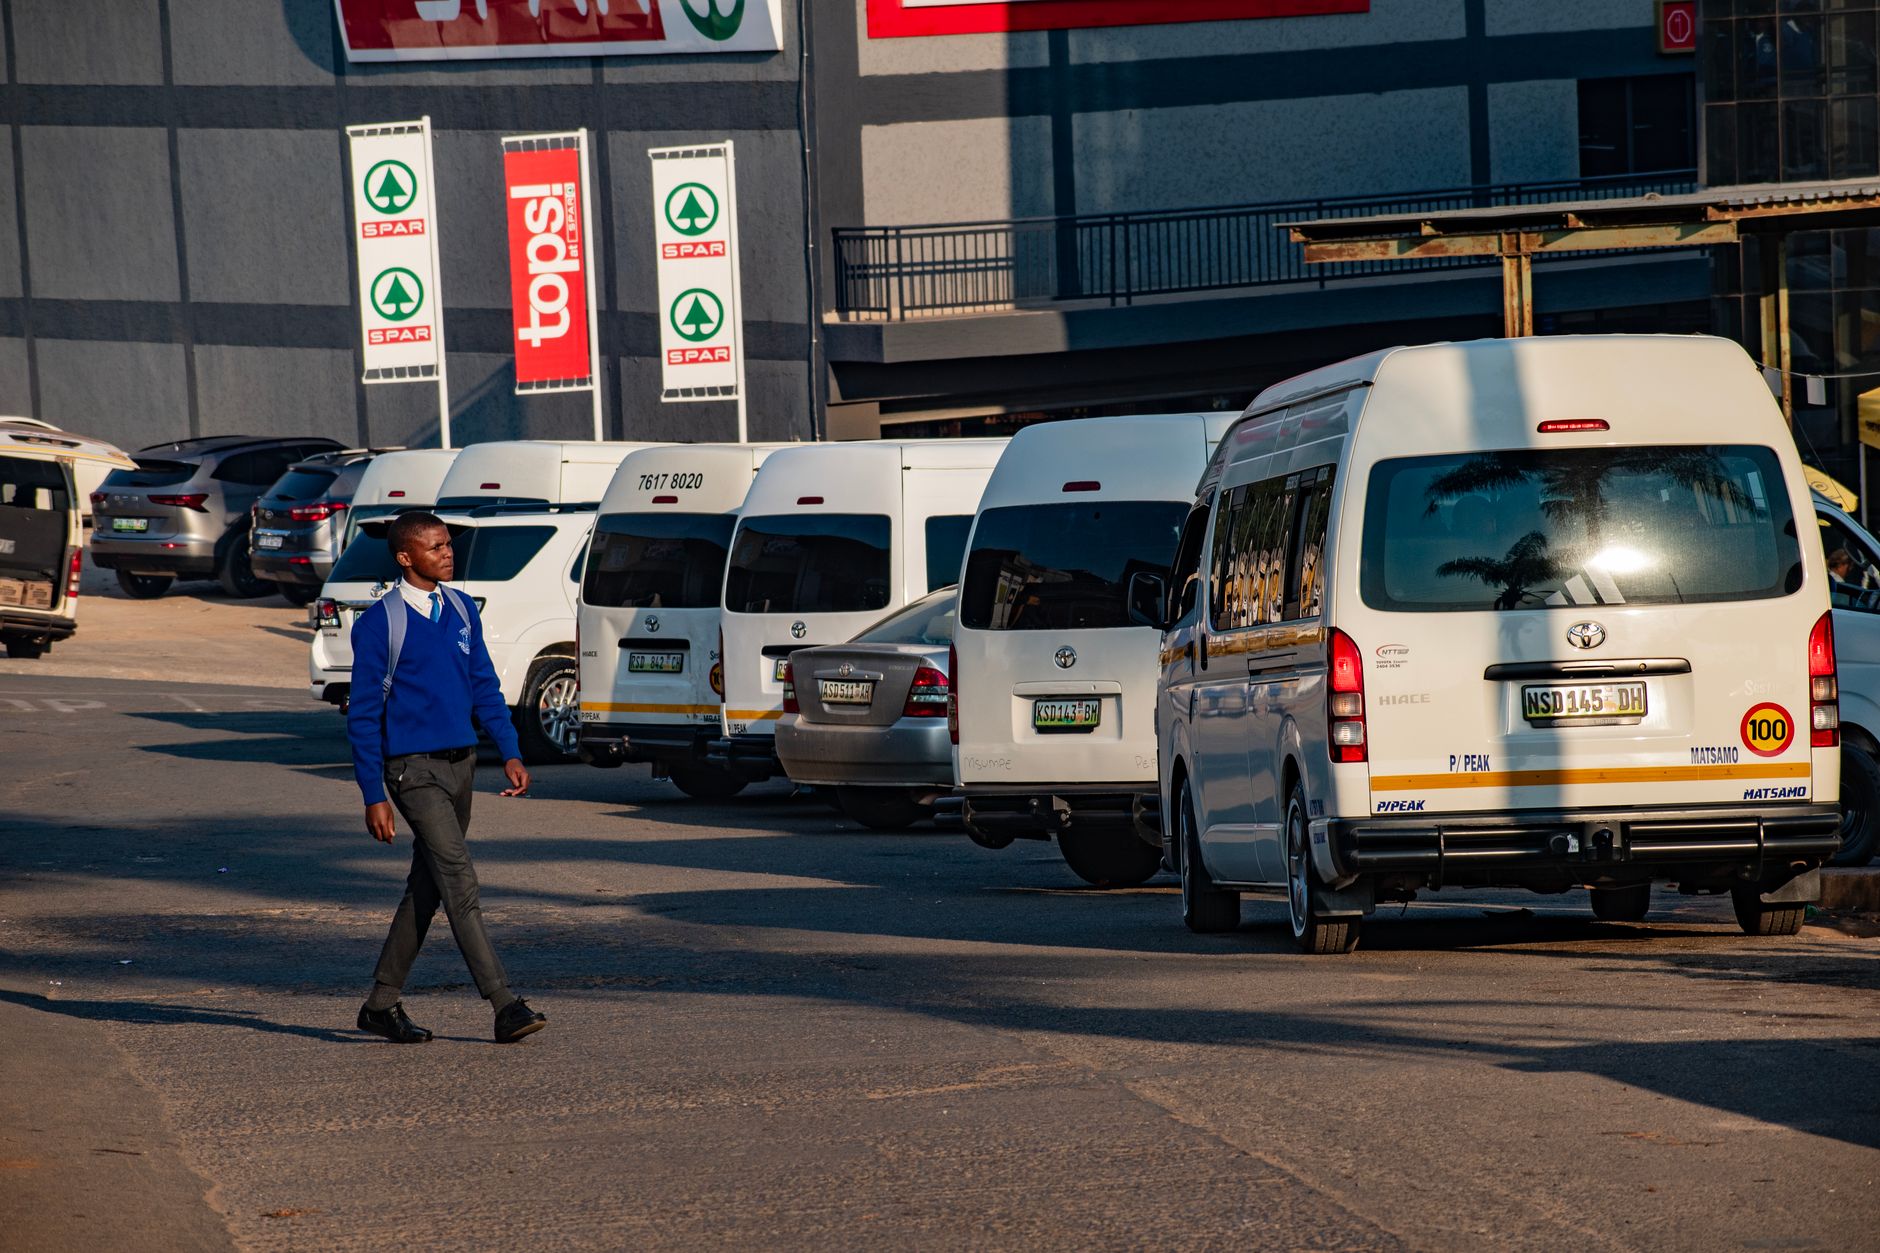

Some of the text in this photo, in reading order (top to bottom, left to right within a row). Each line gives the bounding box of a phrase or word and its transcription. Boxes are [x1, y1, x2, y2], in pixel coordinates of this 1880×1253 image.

[363, 221, 423, 236] SPAR
[567, 197, 579, 257] at SPAR
[664, 242, 724, 257] SPAR
[369, 327, 429, 343] SPAR
[669, 348, 728, 363] SPAR
[638, 472, 703, 490] 7617 8020
[630, 655, 681, 670] RSD 842 CH
[1379, 693, 1431, 706] HIACE
[1527, 687, 1643, 714] NSD 145 DH
[1084, 703, 1098, 722] BM
[1749, 718, 1787, 741] 100
[1464, 754, 1490, 772] PEAK
[1690, 746, 1739, 764] MATSAMO
[1743, 786, 1807, 800] MATSAMO
[1376, 799, 1426, 812] P/PEAK
